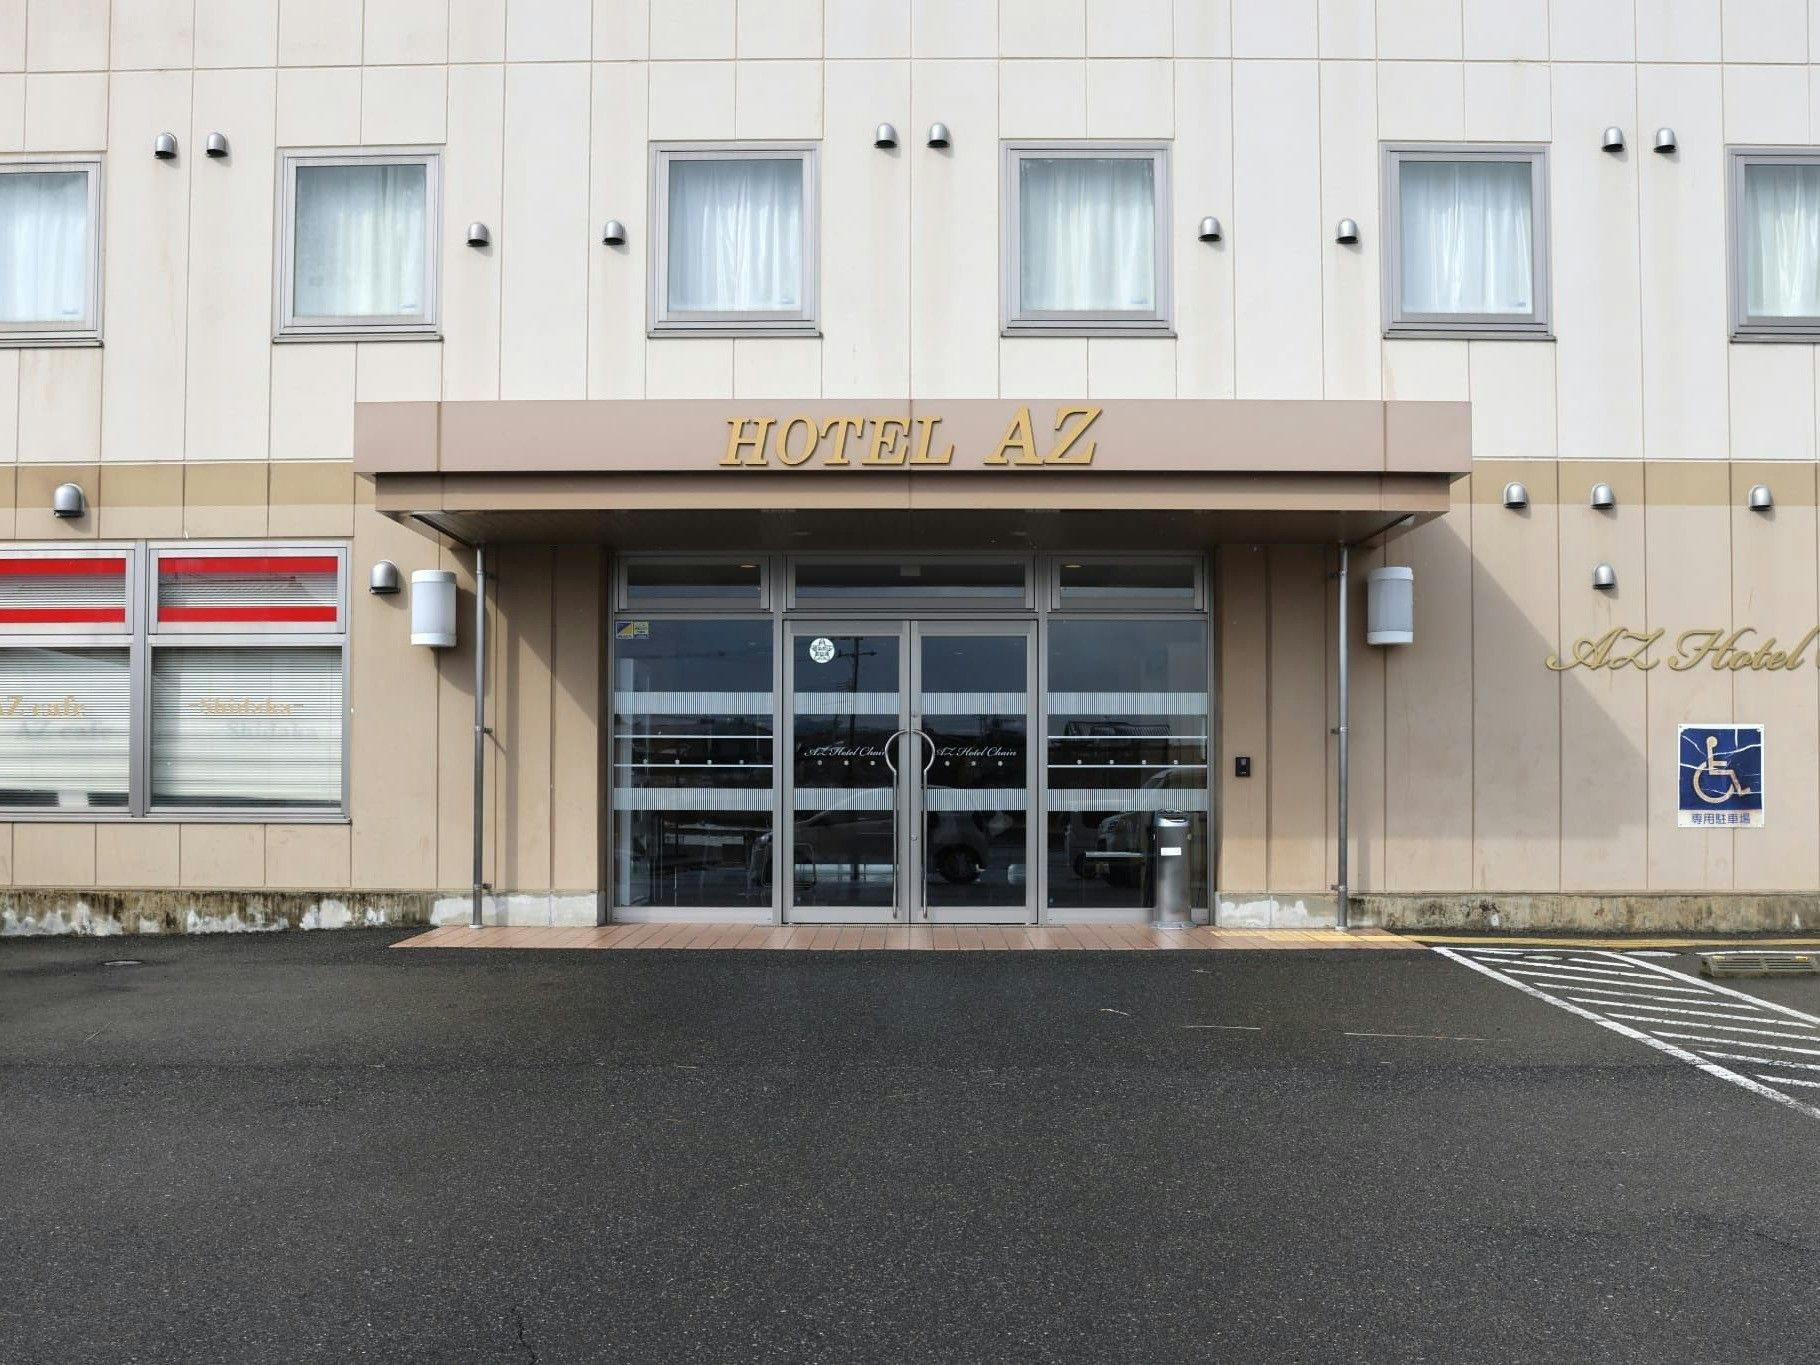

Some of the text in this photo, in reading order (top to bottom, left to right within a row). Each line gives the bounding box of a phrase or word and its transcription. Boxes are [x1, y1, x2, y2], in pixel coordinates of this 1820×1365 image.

[719, 406, 1102, 466] HOTEL AZ
[1546, 627, 1666, 671] AZ
[1668, 626, 1820, 671] Hotel
[804, 745, 829, 757] AZ
[829, 745, 860, 757] Hotel
[936, 745, 1017, 757] AZ Hotel Chain
[1691, 812, 1751, 825] 専用駐車場
